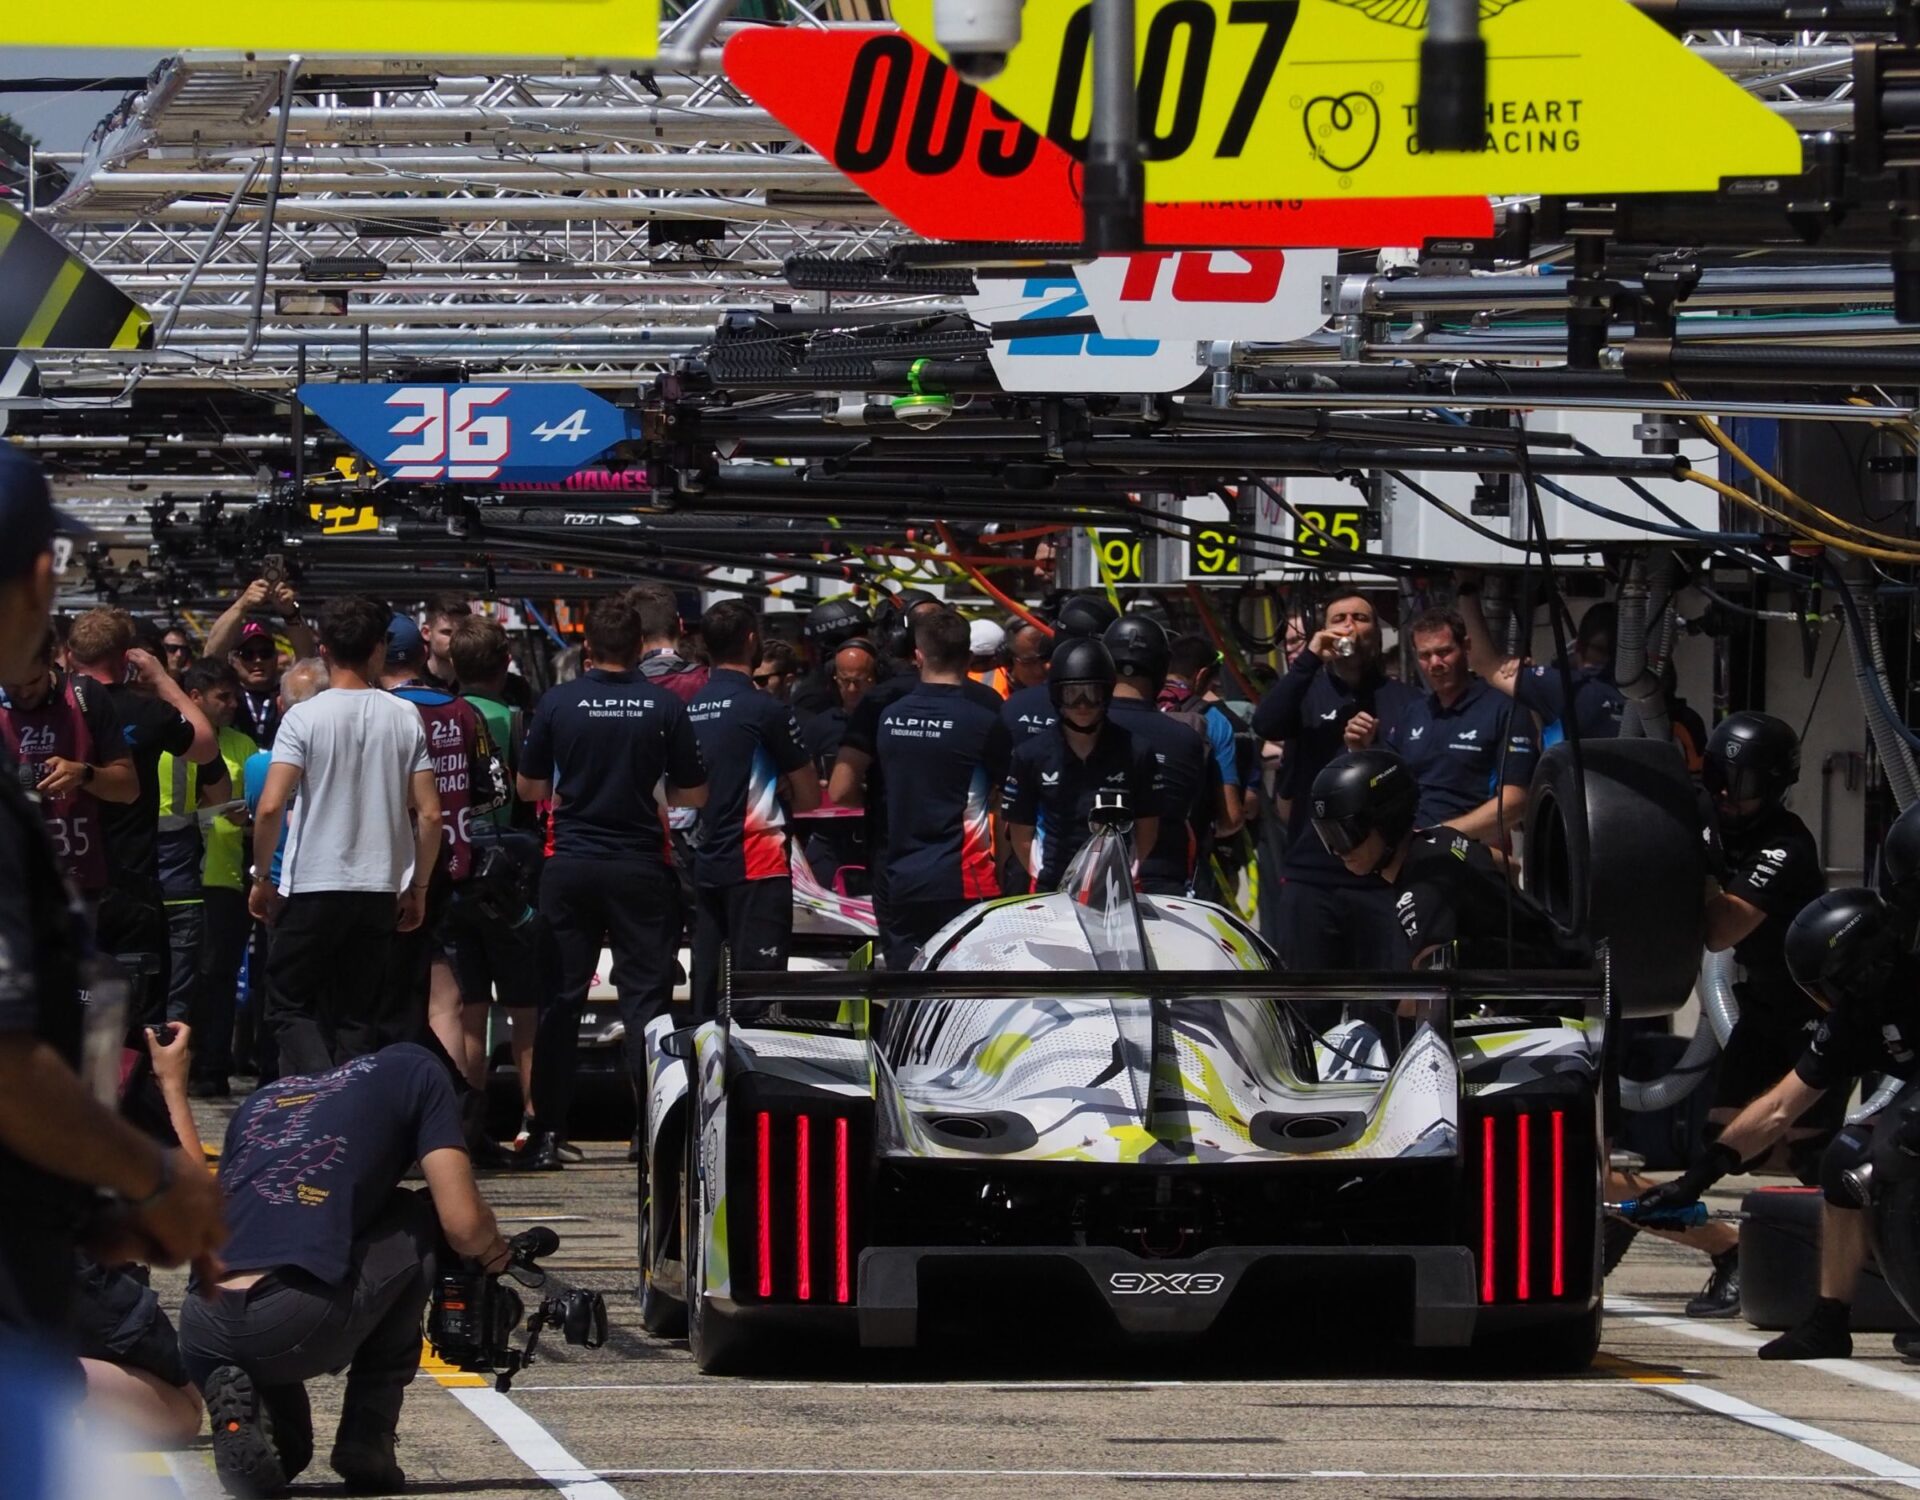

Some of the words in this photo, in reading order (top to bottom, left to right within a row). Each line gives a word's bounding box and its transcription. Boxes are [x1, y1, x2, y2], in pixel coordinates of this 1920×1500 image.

[1047, 0, 1299, 162] 007
[1486, 100, 1582, 124] HEART
[1460, 130, 1580, 154] ACING
[384, 387, 512, 464] 36
[815, 614, 860, 634] uvex
[74, 685, 88, 713] Canon
[577, 699, 655, 708] ALPINE
[589, 710, 624, 718] ENDURANCE
[626, 710, 643, 718] TEAM
[883, 716, 954, 729] ALPINE
[891, 728, 922, 737] ENDURANCE
[1109, 1272, 1224, 1294] 9X8
